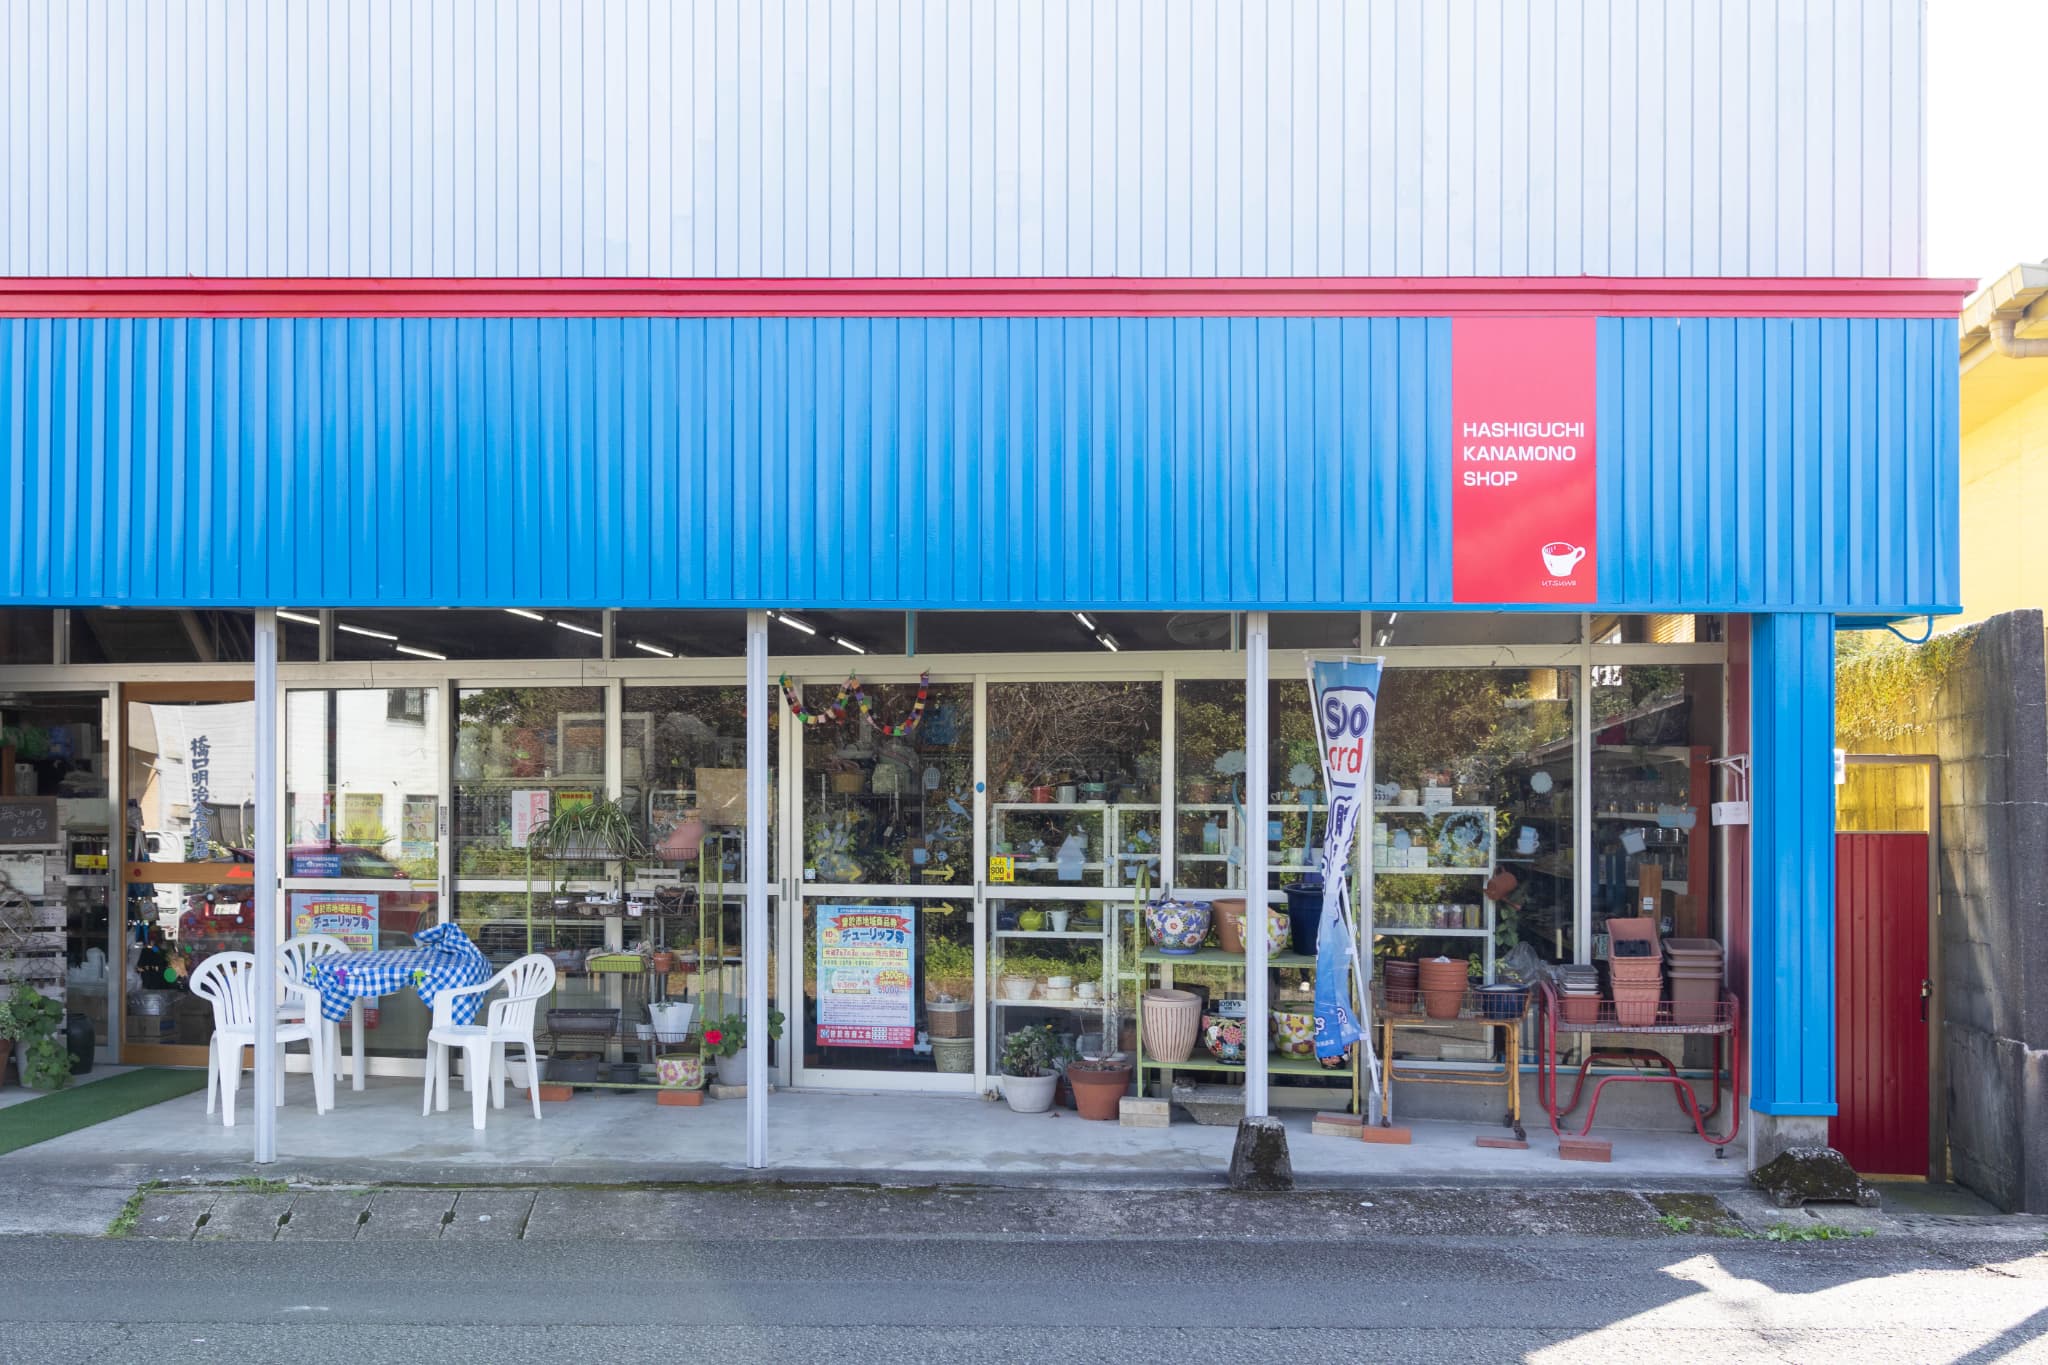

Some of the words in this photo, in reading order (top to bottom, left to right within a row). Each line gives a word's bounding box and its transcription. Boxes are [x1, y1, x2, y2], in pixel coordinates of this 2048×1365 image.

[1463, 422, 1585, 438] HASHIGUCHI
[1463, 446, 1577, 461] KANAMONO
[1463, 471, 1518, 486] SHOP
